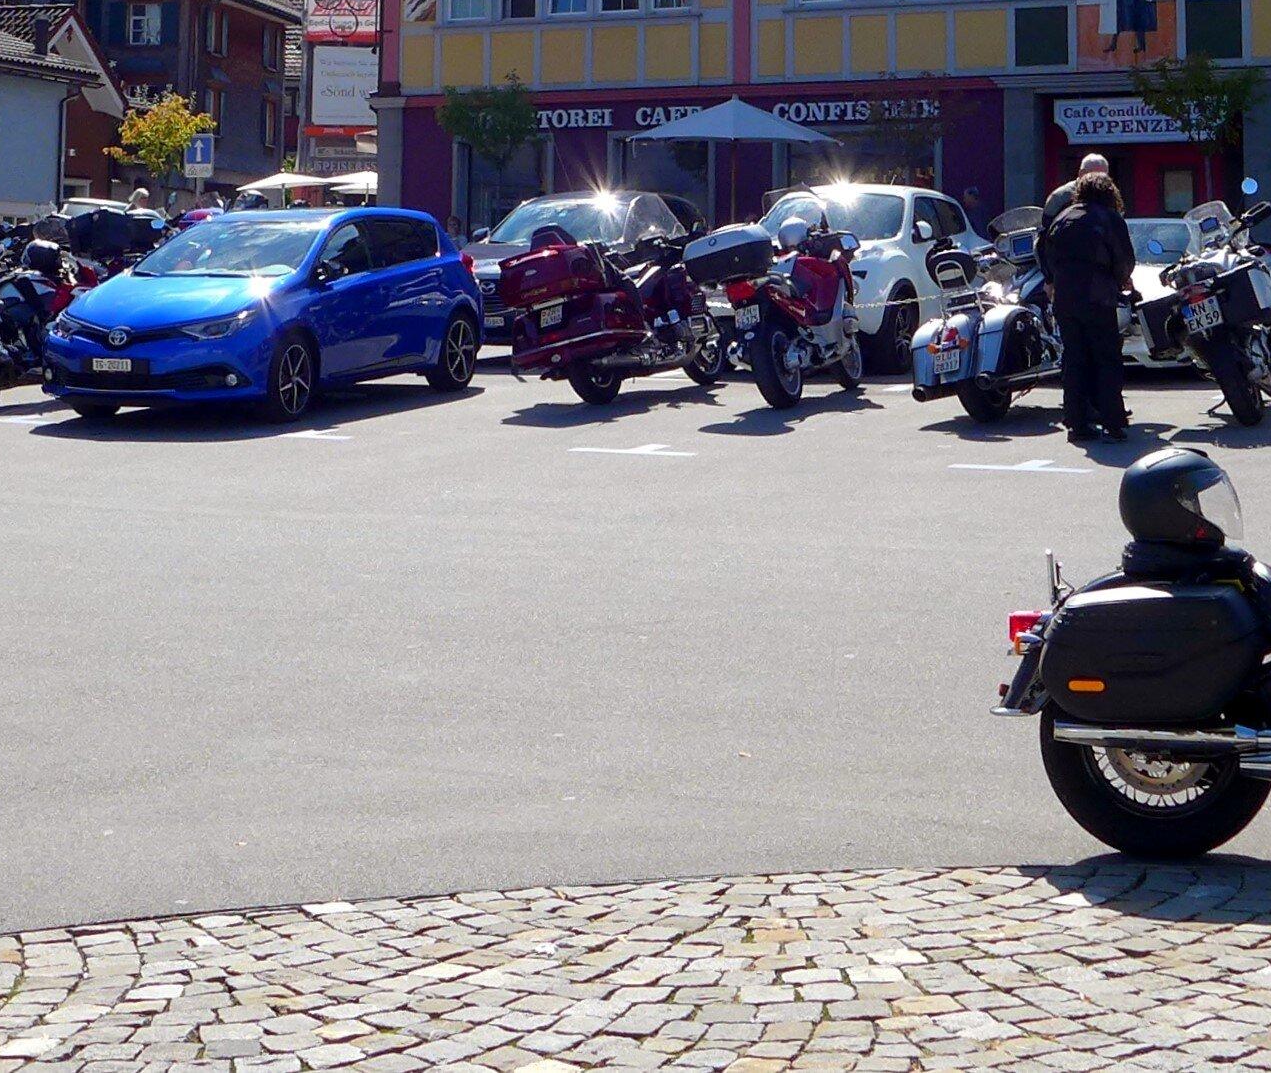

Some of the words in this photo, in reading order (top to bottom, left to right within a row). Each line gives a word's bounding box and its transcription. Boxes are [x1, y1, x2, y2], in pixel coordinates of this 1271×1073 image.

[1097, 106, 1156, 118] Condito
[1075, 118, 1180, 135] APPENZE
[1190, 303, 1206, 317] KN
[1205, 310, 1220, 325] 59
